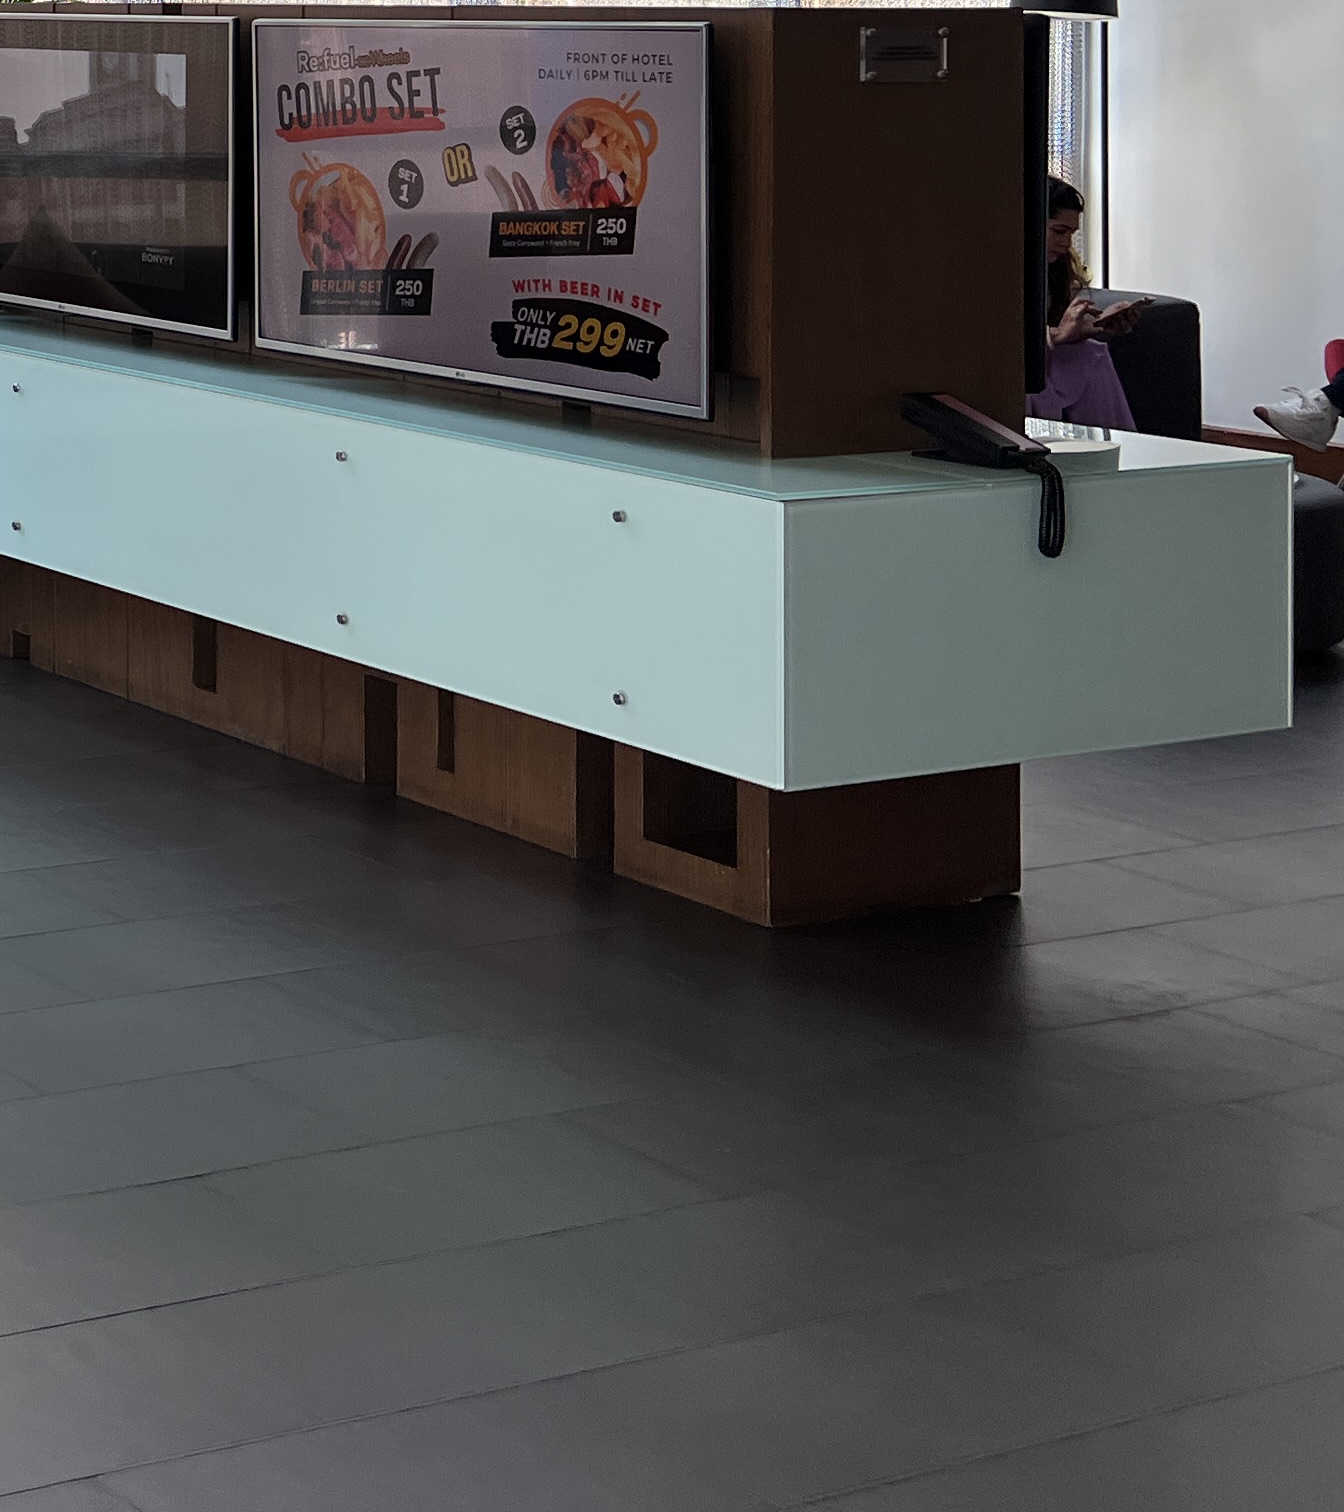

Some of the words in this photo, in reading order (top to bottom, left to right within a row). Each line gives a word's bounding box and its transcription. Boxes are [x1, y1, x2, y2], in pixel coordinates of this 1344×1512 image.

[566, 52, 607, 64] FRONT
[610, 53, 628, 65] OF
[631, 54, 673, 66] HOTEL
[538, 68, 573, 80] DAILY
[583, 69, 610, 81] 6PM
[613, 70, 638, 83] TILL
[642, 71, 673, 84] LATE
[277, 74, 377, 131] COMBO
[386, 67, 441, 121] SET
[505, 112, 525, 130] SET
[513, 128, 529, 149] 2
[442, 142, 478, 187] OR
[398, 167, 418, 183] SET
[398, 183, 410, 203] 1
[498, 221, 559, 236] BANGKOK
[561, 221, 586, 236] SET
[596, 218, 627, 235] 250
[602, 236, 618, 247] THB
[312, 279, 356, 293] BERLIN
[359, 280, 384, 294] SET
[395, 279, 423, 296] 250
[400, 297, 415, 308] THB
[512, 279, 552, 294] WITH
[559, 279, 601, 299] BEER
[607, 287, 625, 304] IN
[631, 295, 662, 317] SET
[517, 306, 557, 326] ONLY
[513, 324, 552, 349] THB
[551, 314, 626, 358] 299
[625, 337, 655, 355] NET
